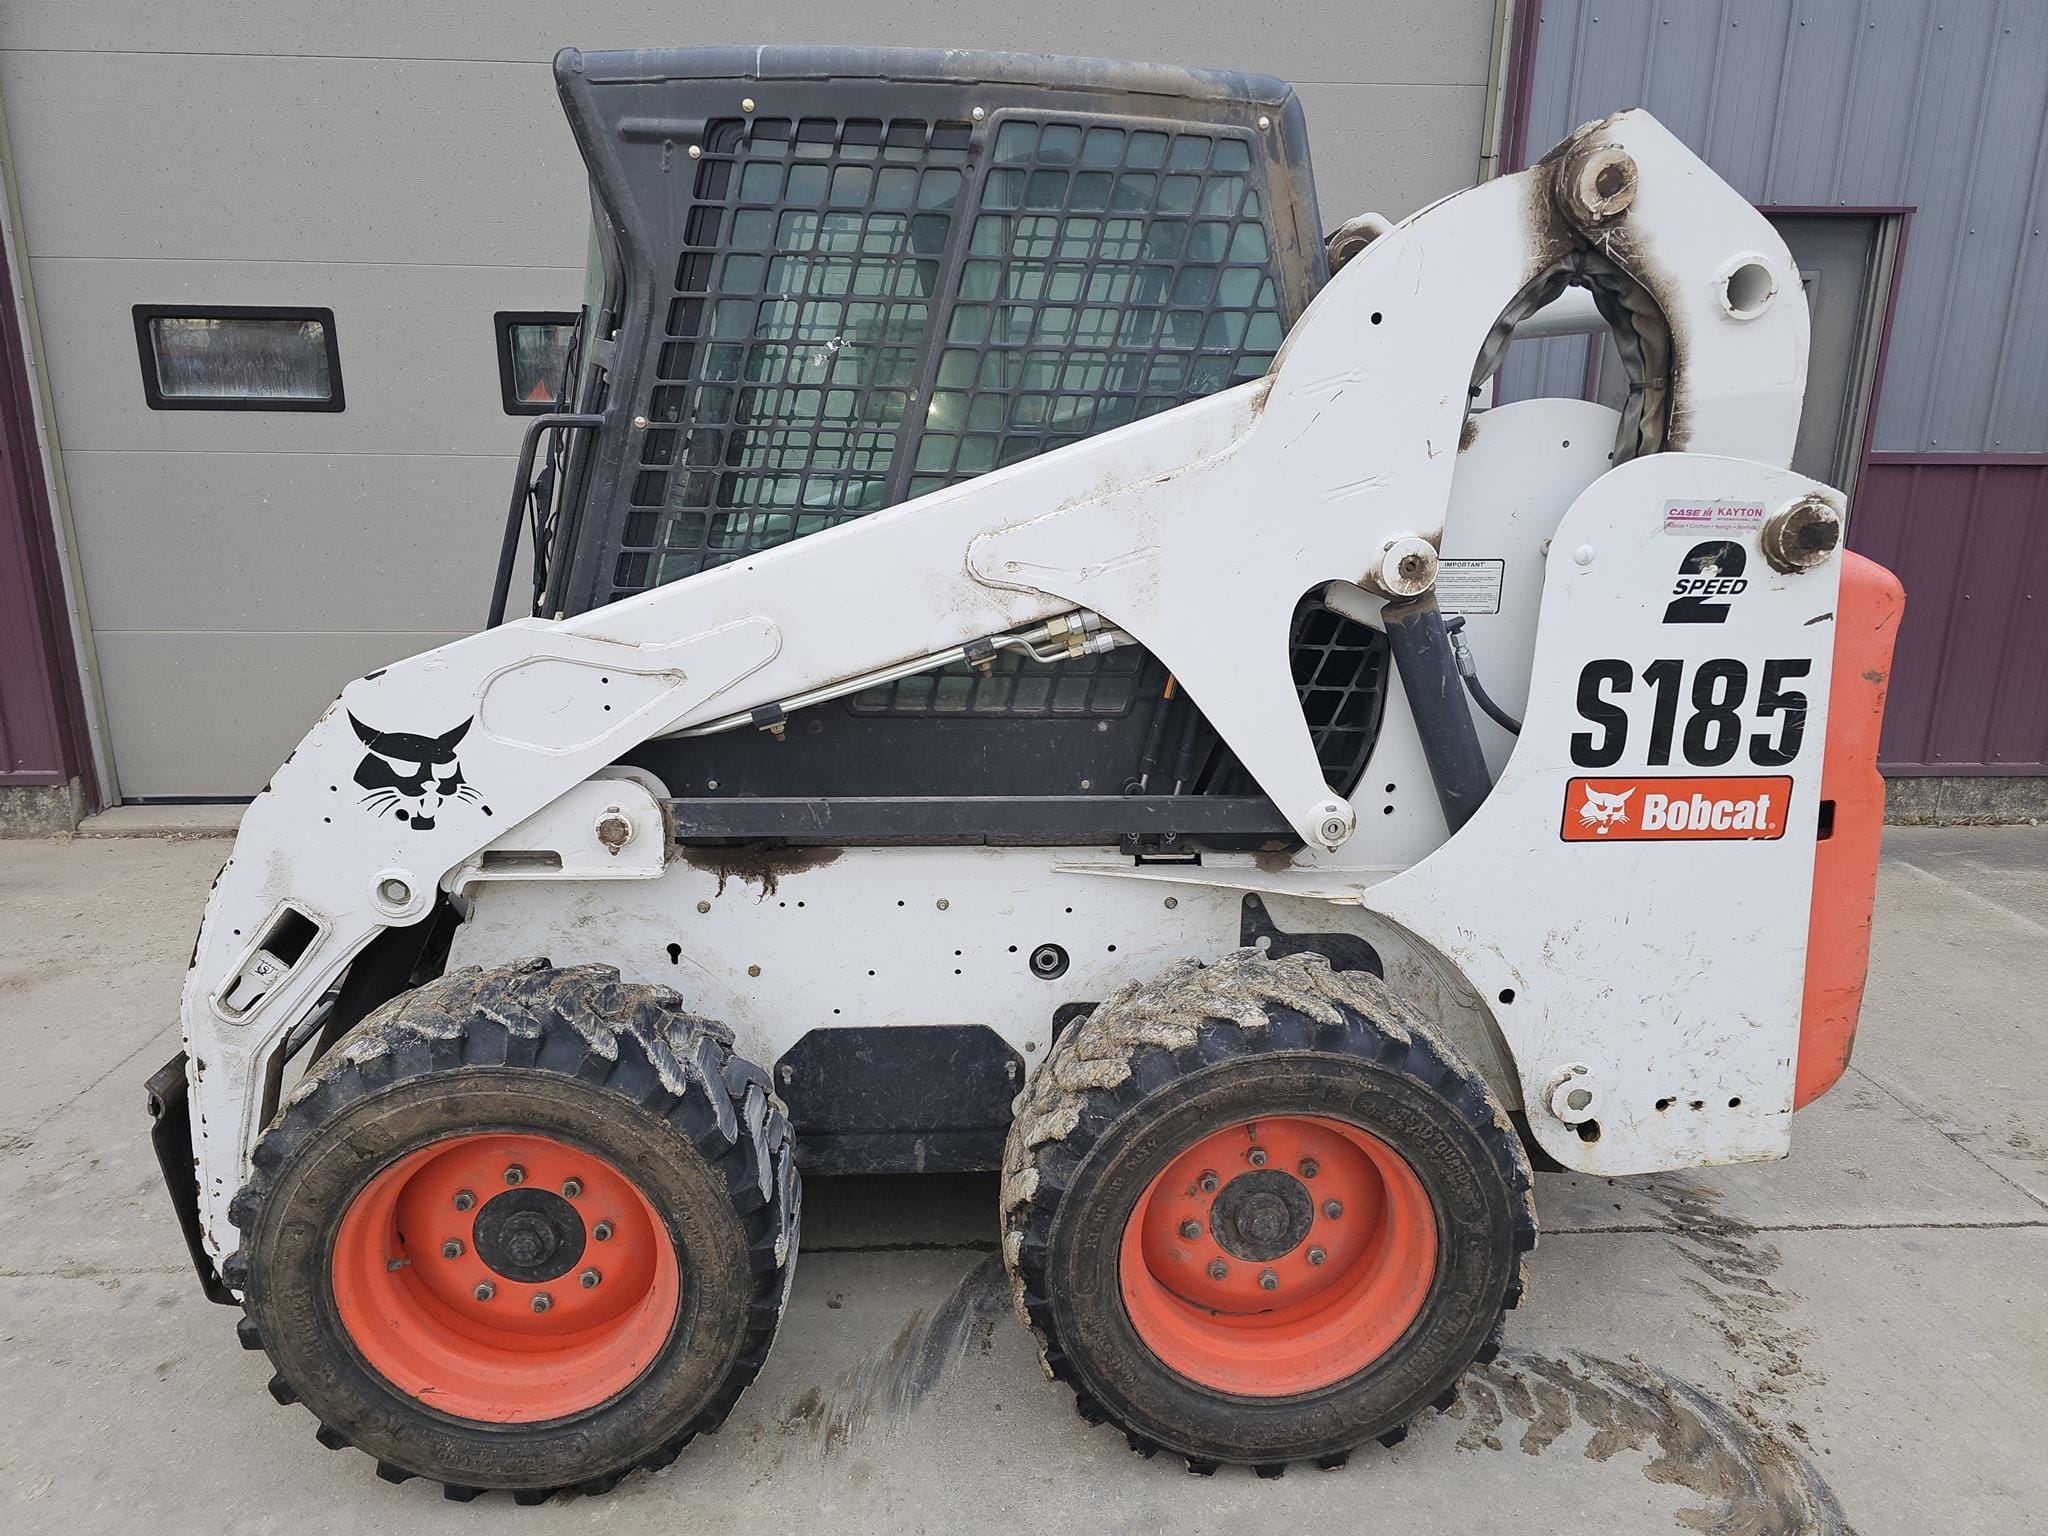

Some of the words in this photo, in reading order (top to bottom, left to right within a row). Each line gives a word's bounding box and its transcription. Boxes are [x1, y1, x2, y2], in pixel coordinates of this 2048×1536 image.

[1669, 508, 1701, 516] CASE
[1717, 507, 1763, 517] KAYTON
[1662, 540, 1747, 624] 2
[1672, 579, 1748, 595] SPEED
[1569, 658, 1812, 768] S185
[1641, 793, 1771, 831] Bobcat
